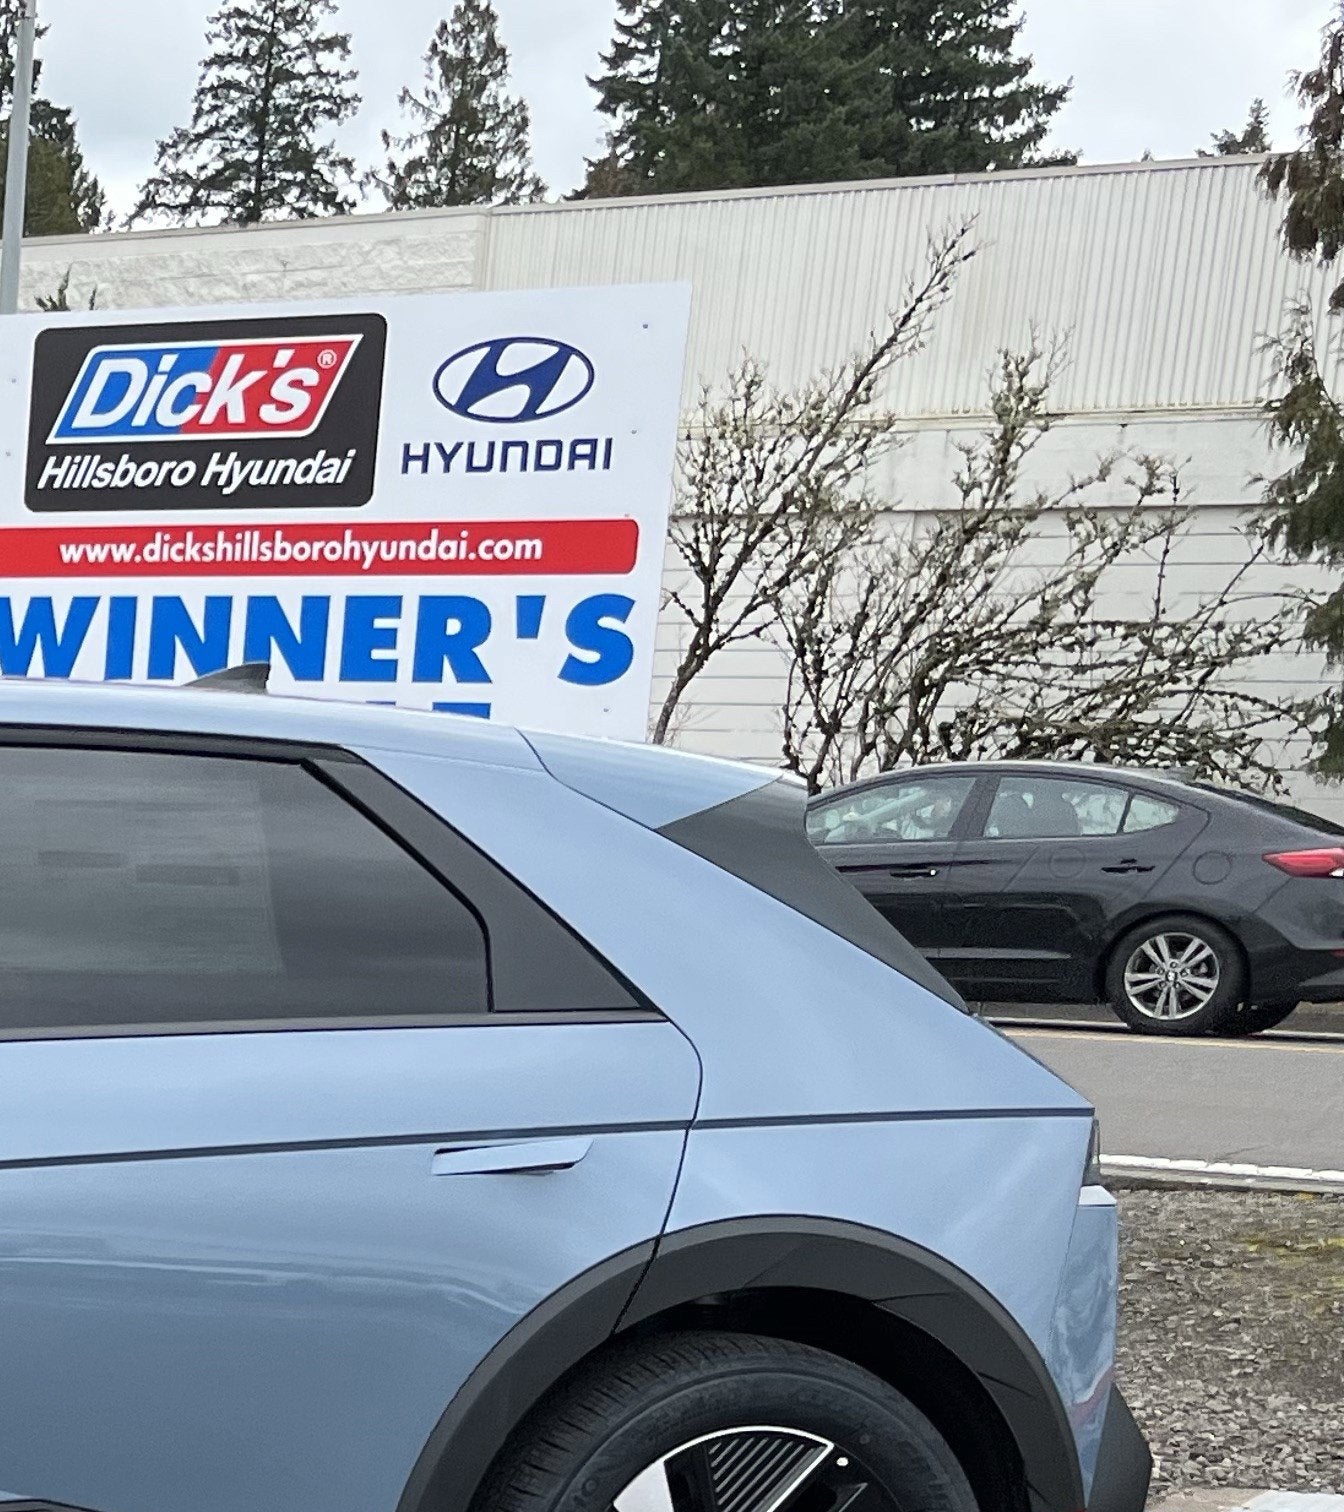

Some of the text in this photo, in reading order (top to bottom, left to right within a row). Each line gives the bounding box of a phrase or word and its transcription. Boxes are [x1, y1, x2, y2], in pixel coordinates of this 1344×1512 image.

[71, 348, 322, 430] Dick's
[37, 449, 357, 495] Hillsboro Hyundai
[401, 437, 613, 475] HYUNDAI
[58, 528, 543, 570] www.dickshillsborohyundai.com
